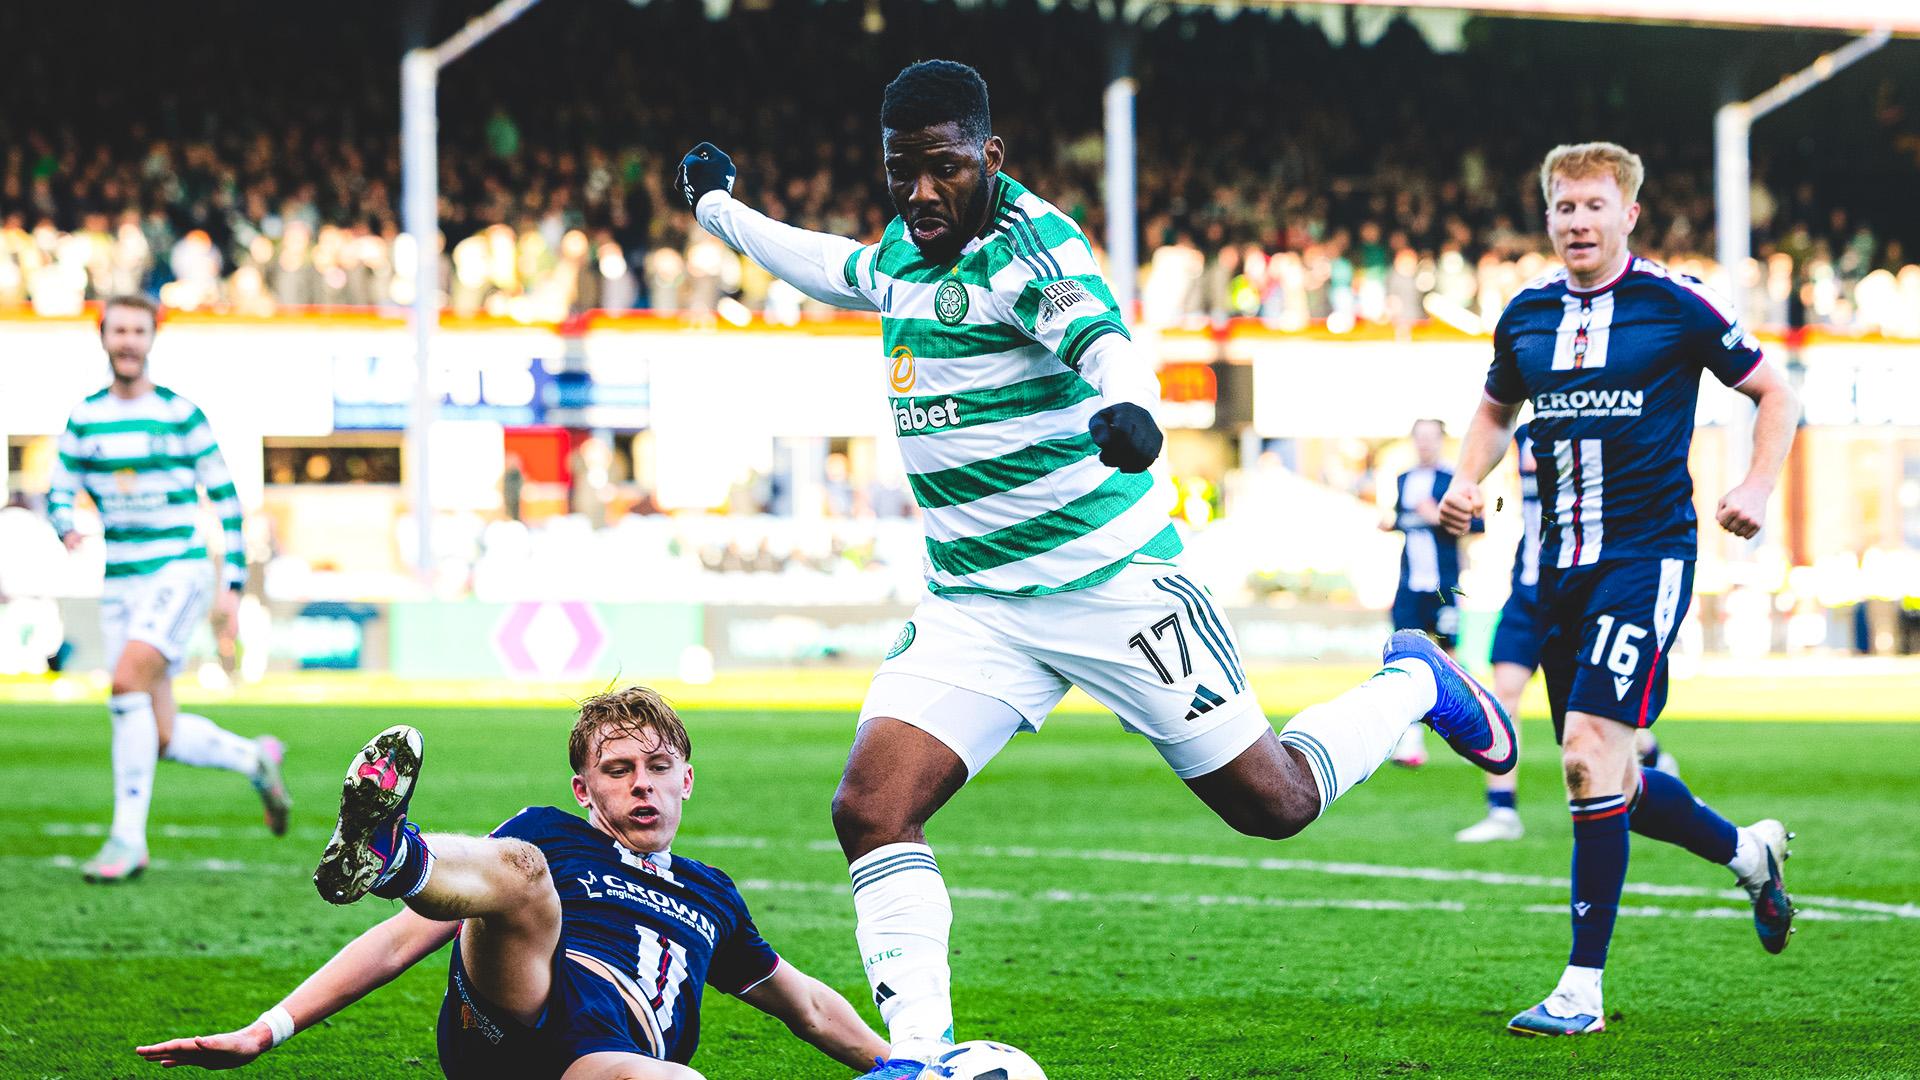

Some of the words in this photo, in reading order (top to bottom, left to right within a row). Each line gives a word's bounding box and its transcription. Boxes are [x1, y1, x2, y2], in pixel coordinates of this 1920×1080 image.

[1536, 390, 1644, 410] CROWN
[1127, 611, 1193, 685] 17
[1590, 614, 1648, 677] 16
[602, 874, 716, 941] CROWN
[606, 888, 661, 913] engineering
